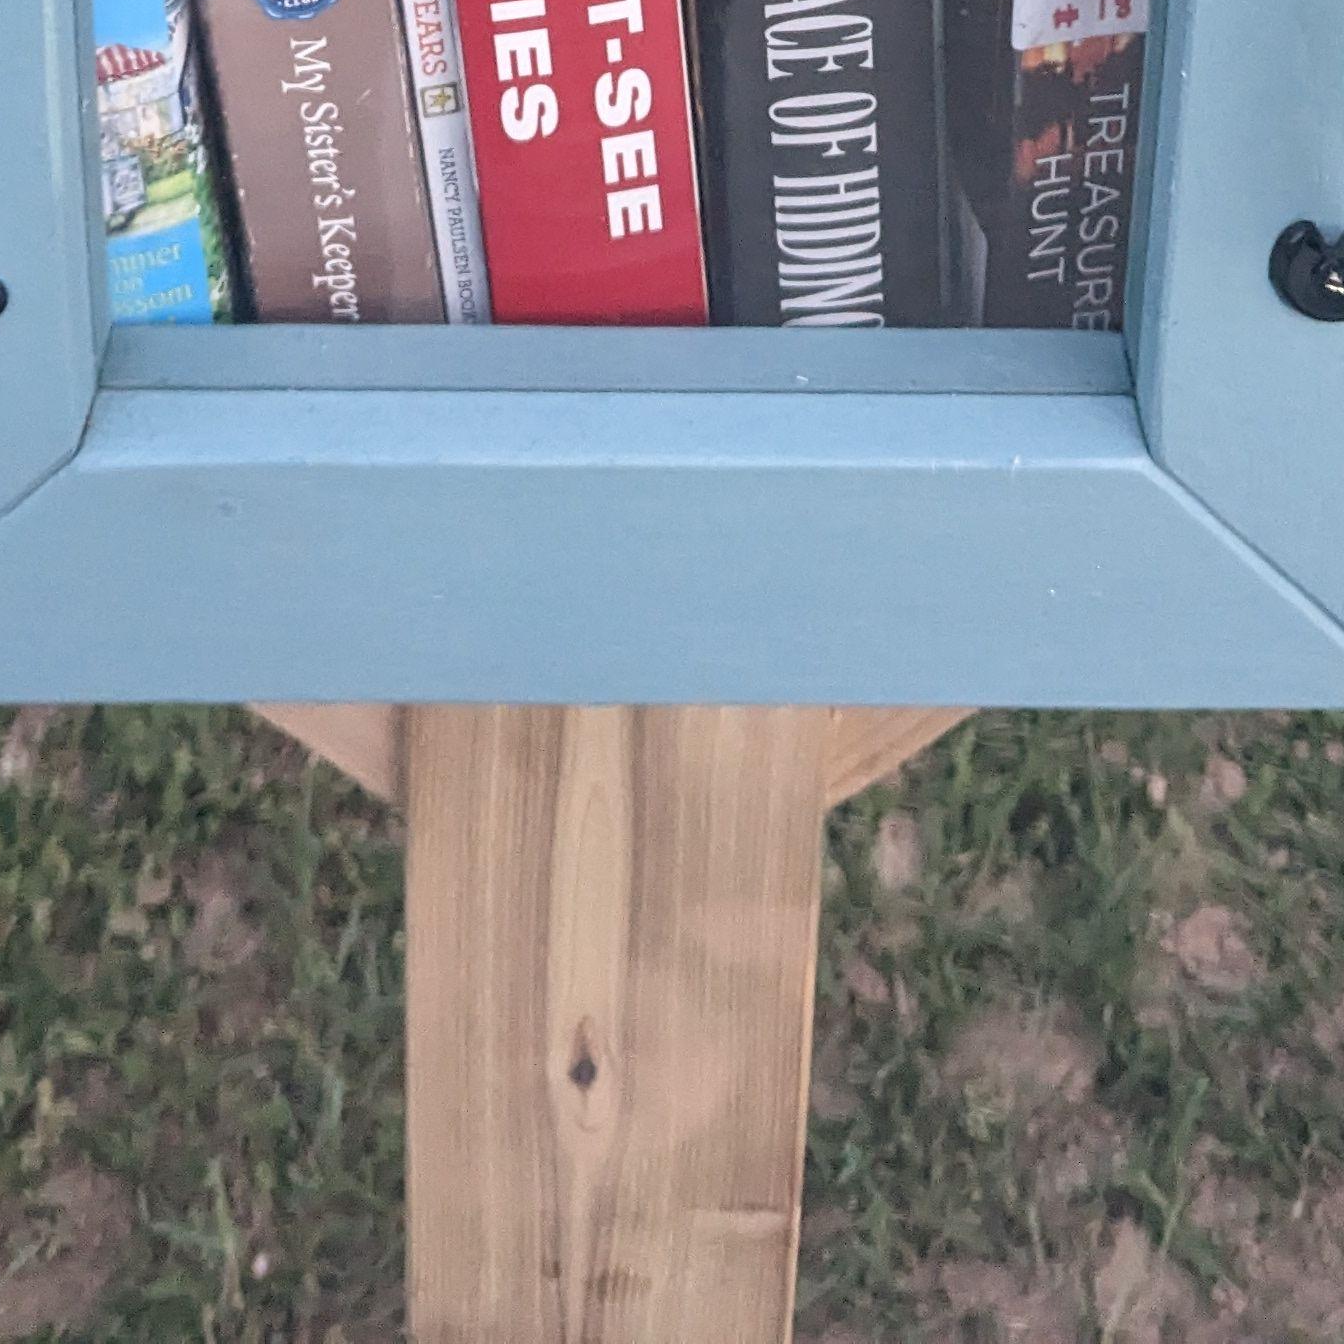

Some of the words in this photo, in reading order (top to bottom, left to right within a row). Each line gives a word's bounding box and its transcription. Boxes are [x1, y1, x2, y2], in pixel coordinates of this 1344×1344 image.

[281, 36, 331, 95] My
[300, 101, 356, 208] Sister's
[768, 90, 878, 157] OF
[438, 147, 461, 204] NANCY
[1072, 82, 1130, 330] TREASURE
[448, 206, 472, 276] PAULSEN
[1027, 153, 1072, 286] HUNT
[312, 215, 361, 320] Keeper
